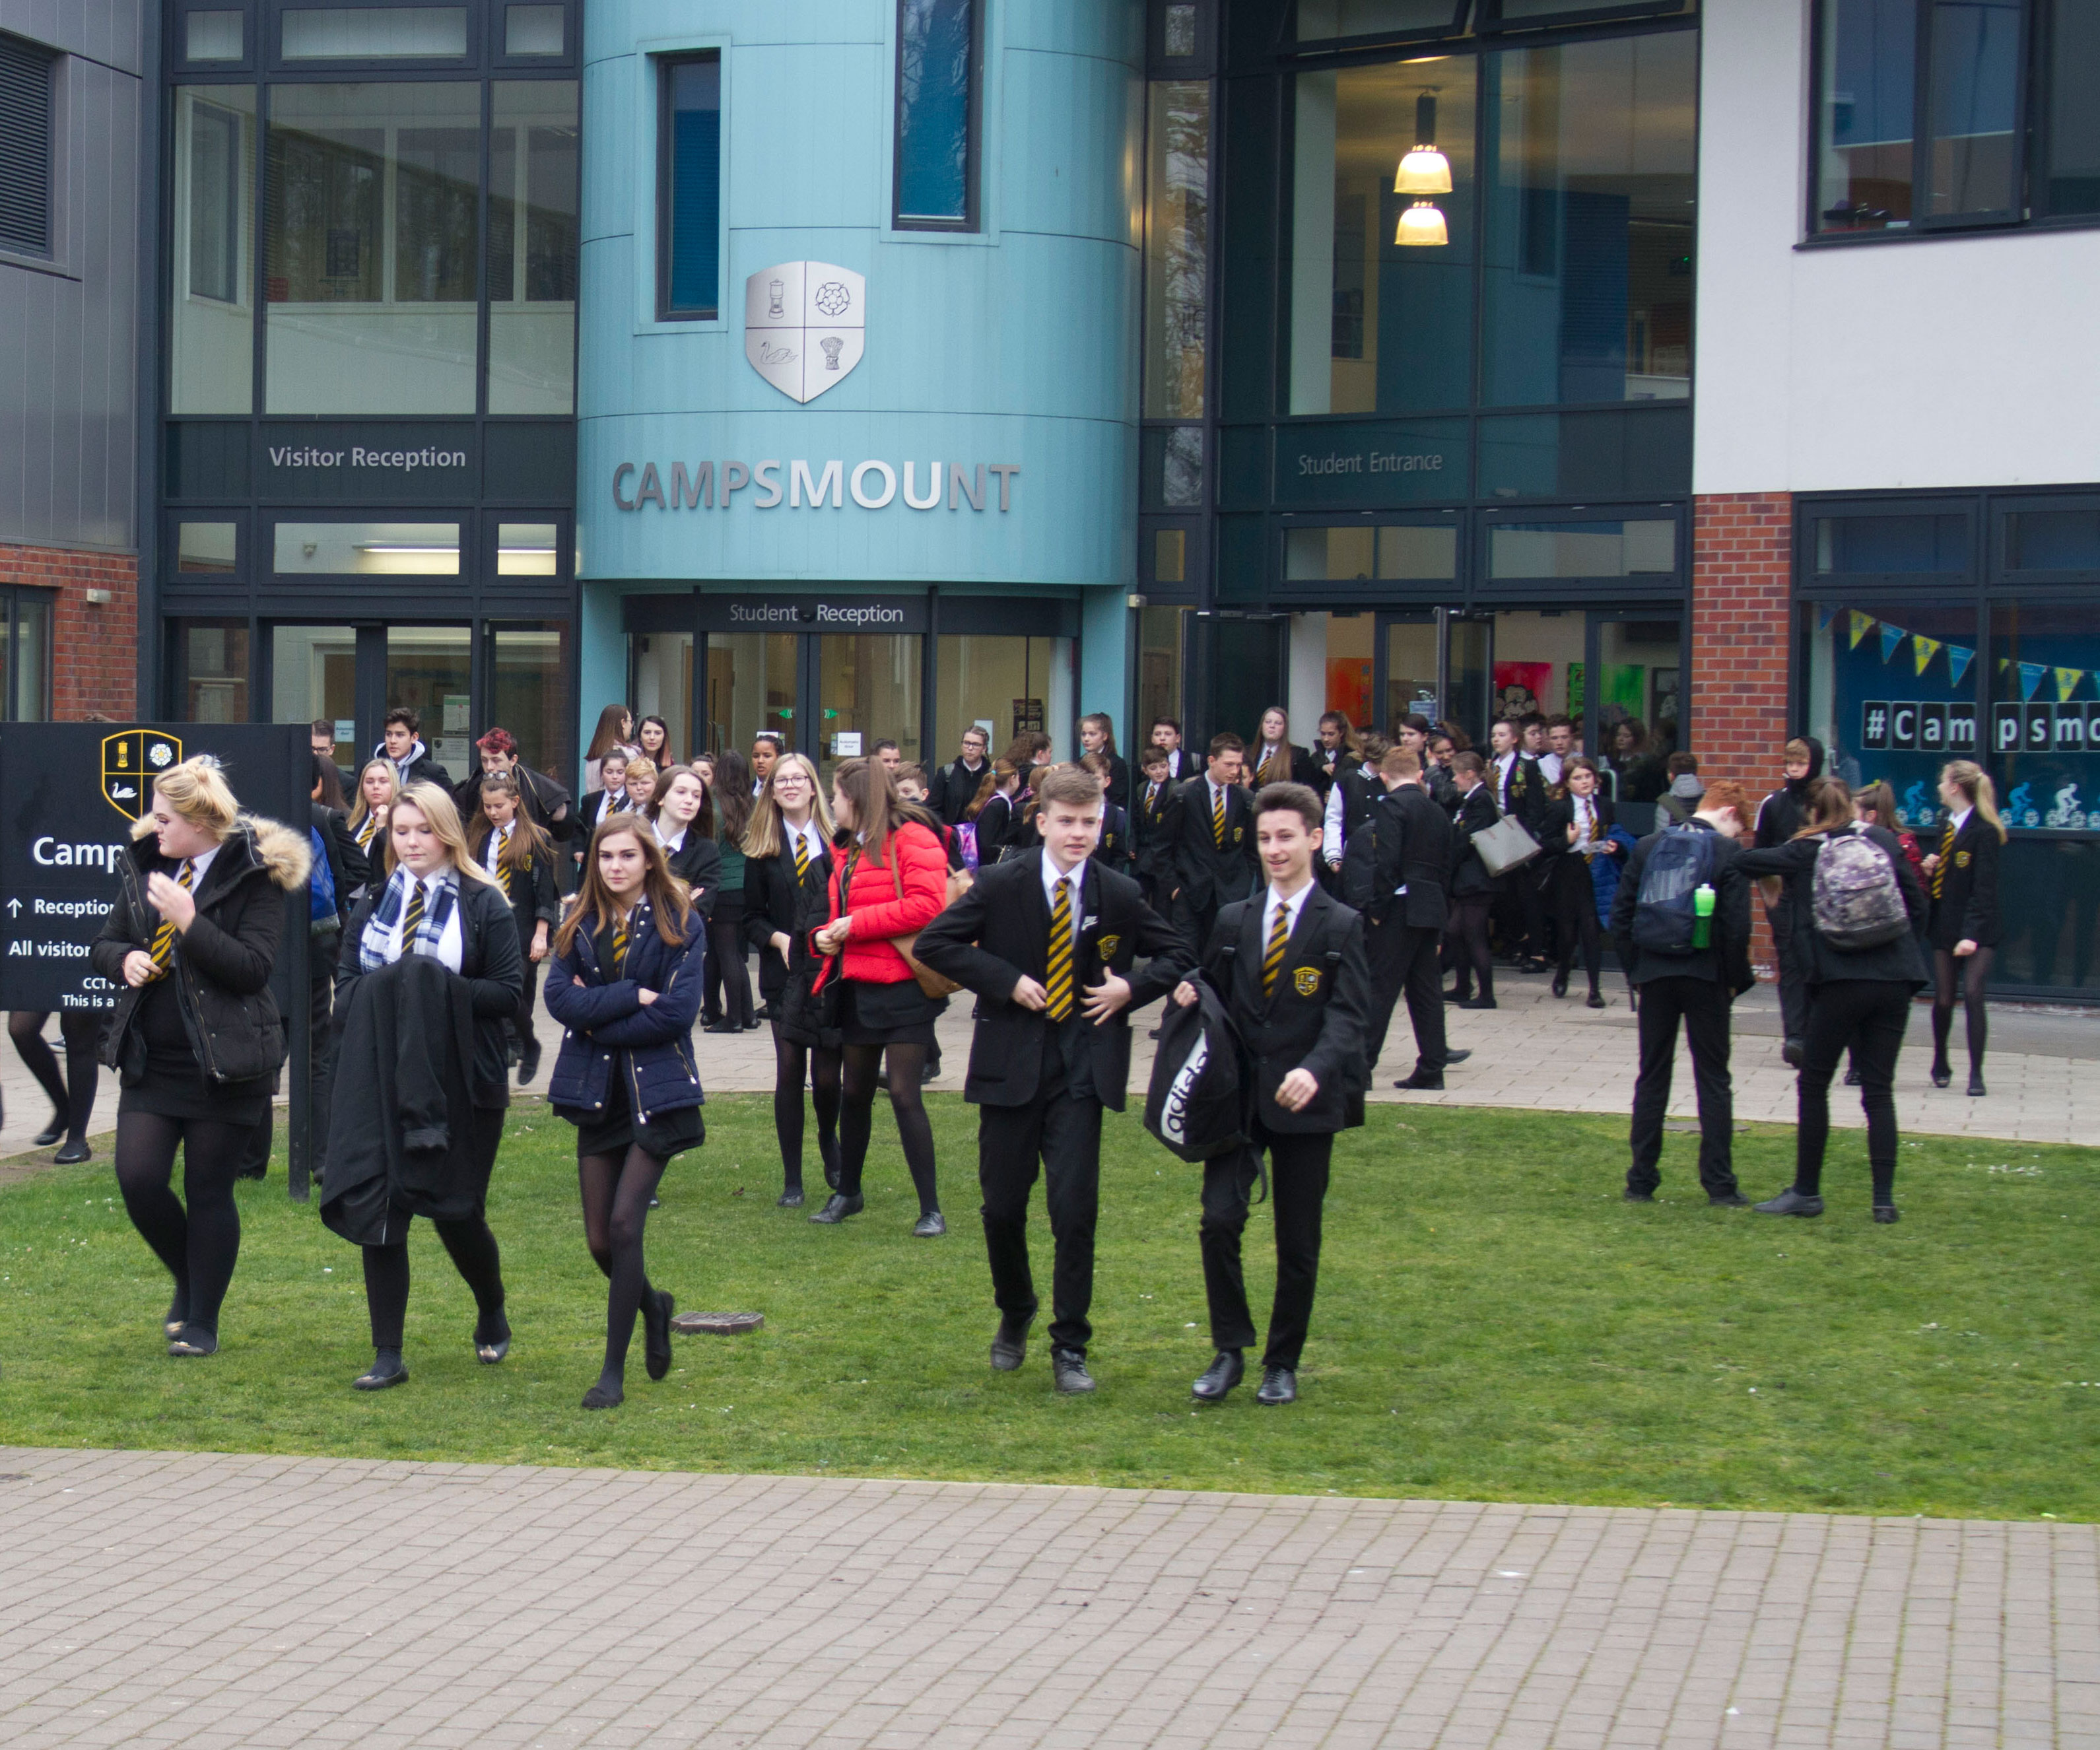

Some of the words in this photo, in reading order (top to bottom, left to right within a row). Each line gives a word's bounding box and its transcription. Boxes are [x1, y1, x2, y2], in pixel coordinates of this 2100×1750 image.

[269, 446, 344, 467] Visitor
[352, 446, 466, 472] Reception
[1298, 452, 1363, 475] Student
[1369, 452, 1442, 473] Entrance
[612, 459, 1021, 512] CAMPSMOUNT
[729, 603, 798, 621] Student
[817, 604, 904, 626] Reception
[9, 940, 32, 956] All
[62, 994, 89, 1007] This
[92, 994, 102, 1007] is
[106, 997, 114, 1007] a
